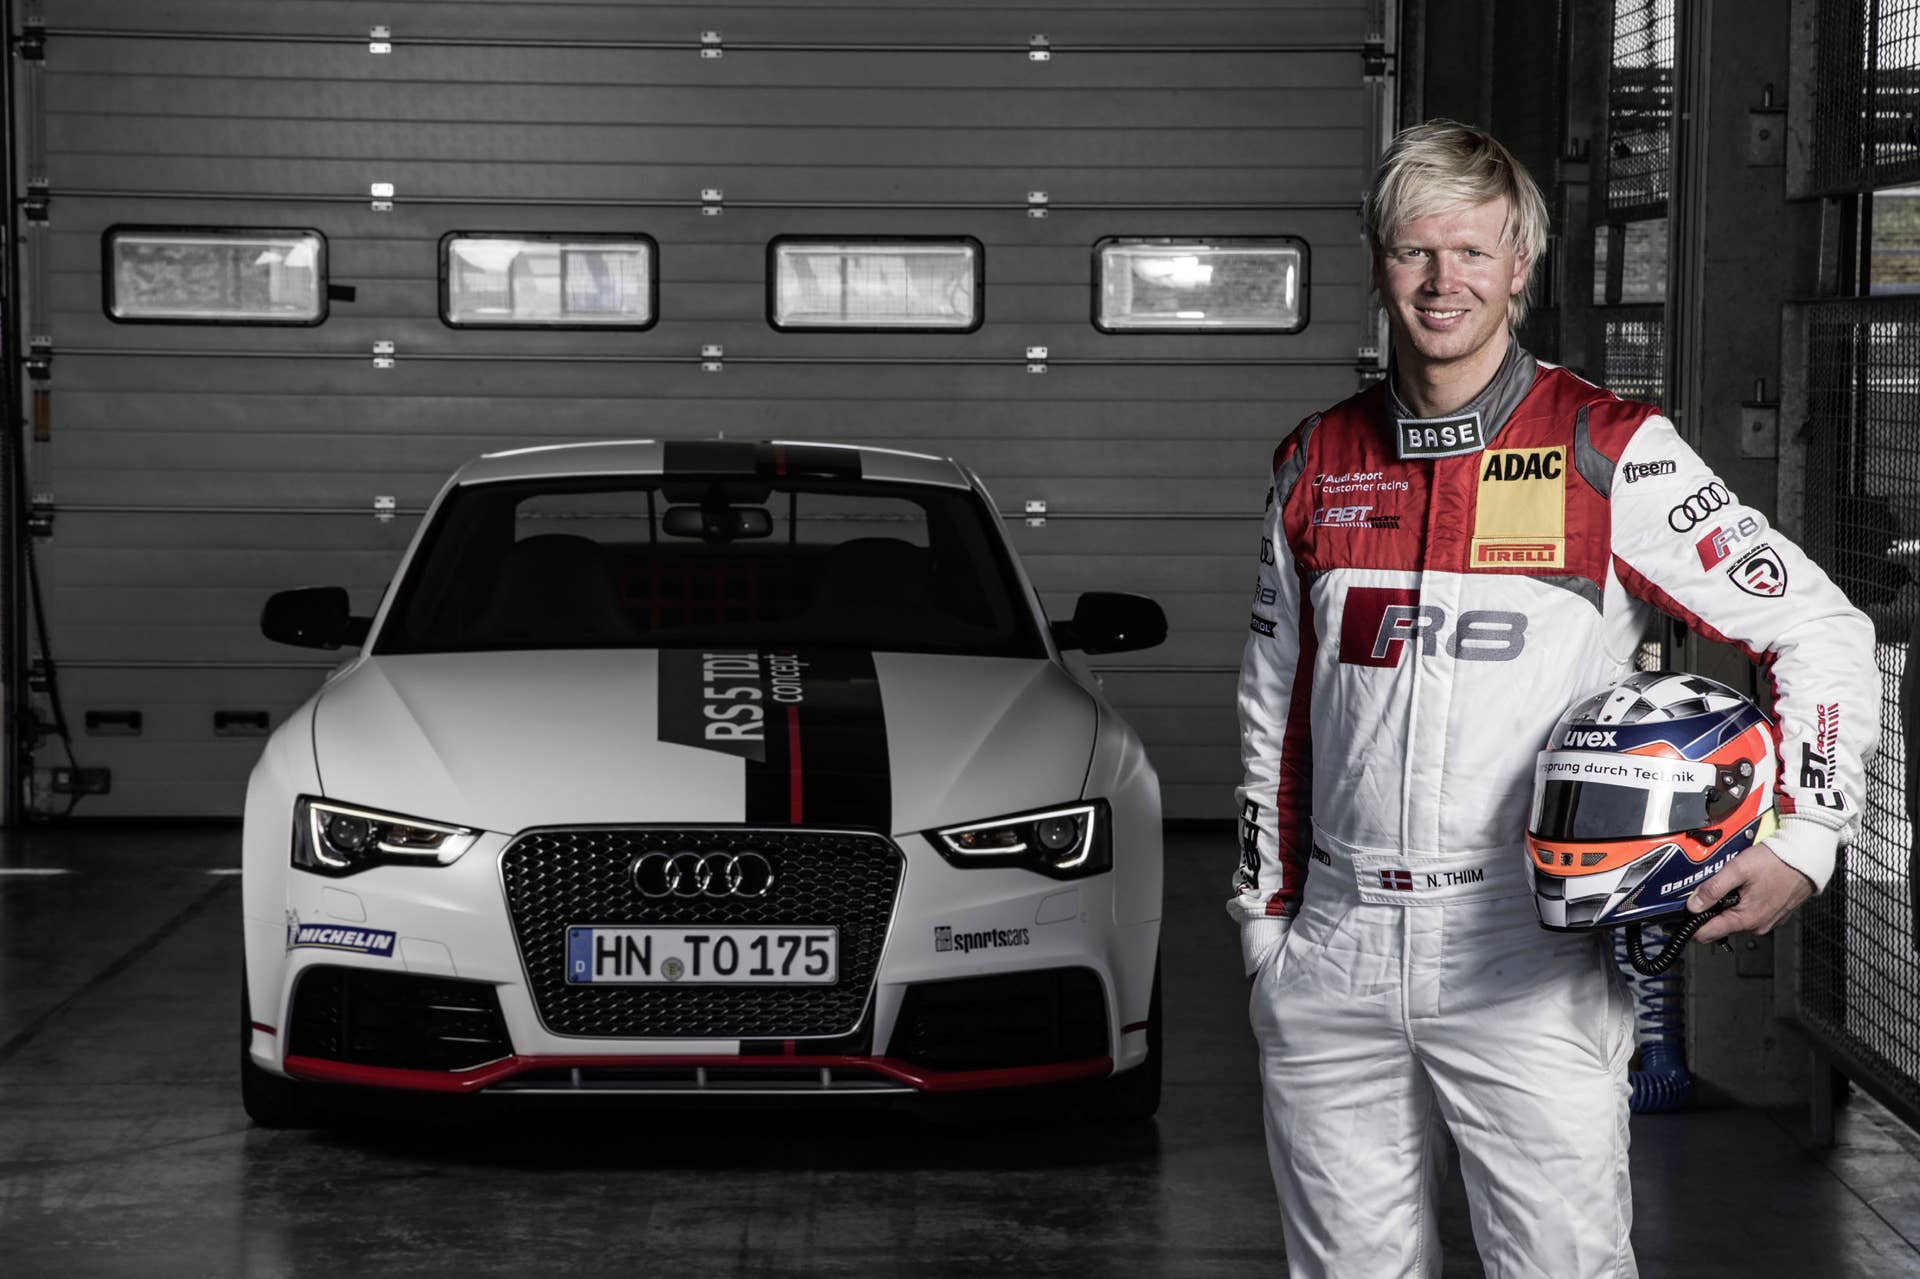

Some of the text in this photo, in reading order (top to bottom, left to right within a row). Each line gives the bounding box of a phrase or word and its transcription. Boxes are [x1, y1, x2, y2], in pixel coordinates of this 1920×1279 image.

[1408, 423, 1475, 448] BASE
[1325, 471, 1383, 484] Audi Sport
[1482, 450, 1562, 482] ADAC
[1623, 459, 1676, 483] freem
[1322, 480, 1409, 494] customer racing
[1711, 515, 1760, 559] R8
[1477, 543, 1557, 563] PIRELLI
[1371, 604, 1529, 662] R8
[702, 653, 760, 682] TDI
[763, 653, 810, 703] concept
[1563, 730, 1618, 747] uvex
[1543, 762, 1580, 775] sprung
[1584, 762, 1628, 776] durch
[1426, 868, 1485, 888] N. THIIM
[1660, 859, 1724, 896] Dansky
[299, 927, 393, 951] MICHELIN
[953, 928, 1030, 954] sportscars
[574, 960, 586, 974] D
[596, 935, 653, 977] HN
[684, 935, 739, 977] TO
[749, 935, 830, 977] 175
